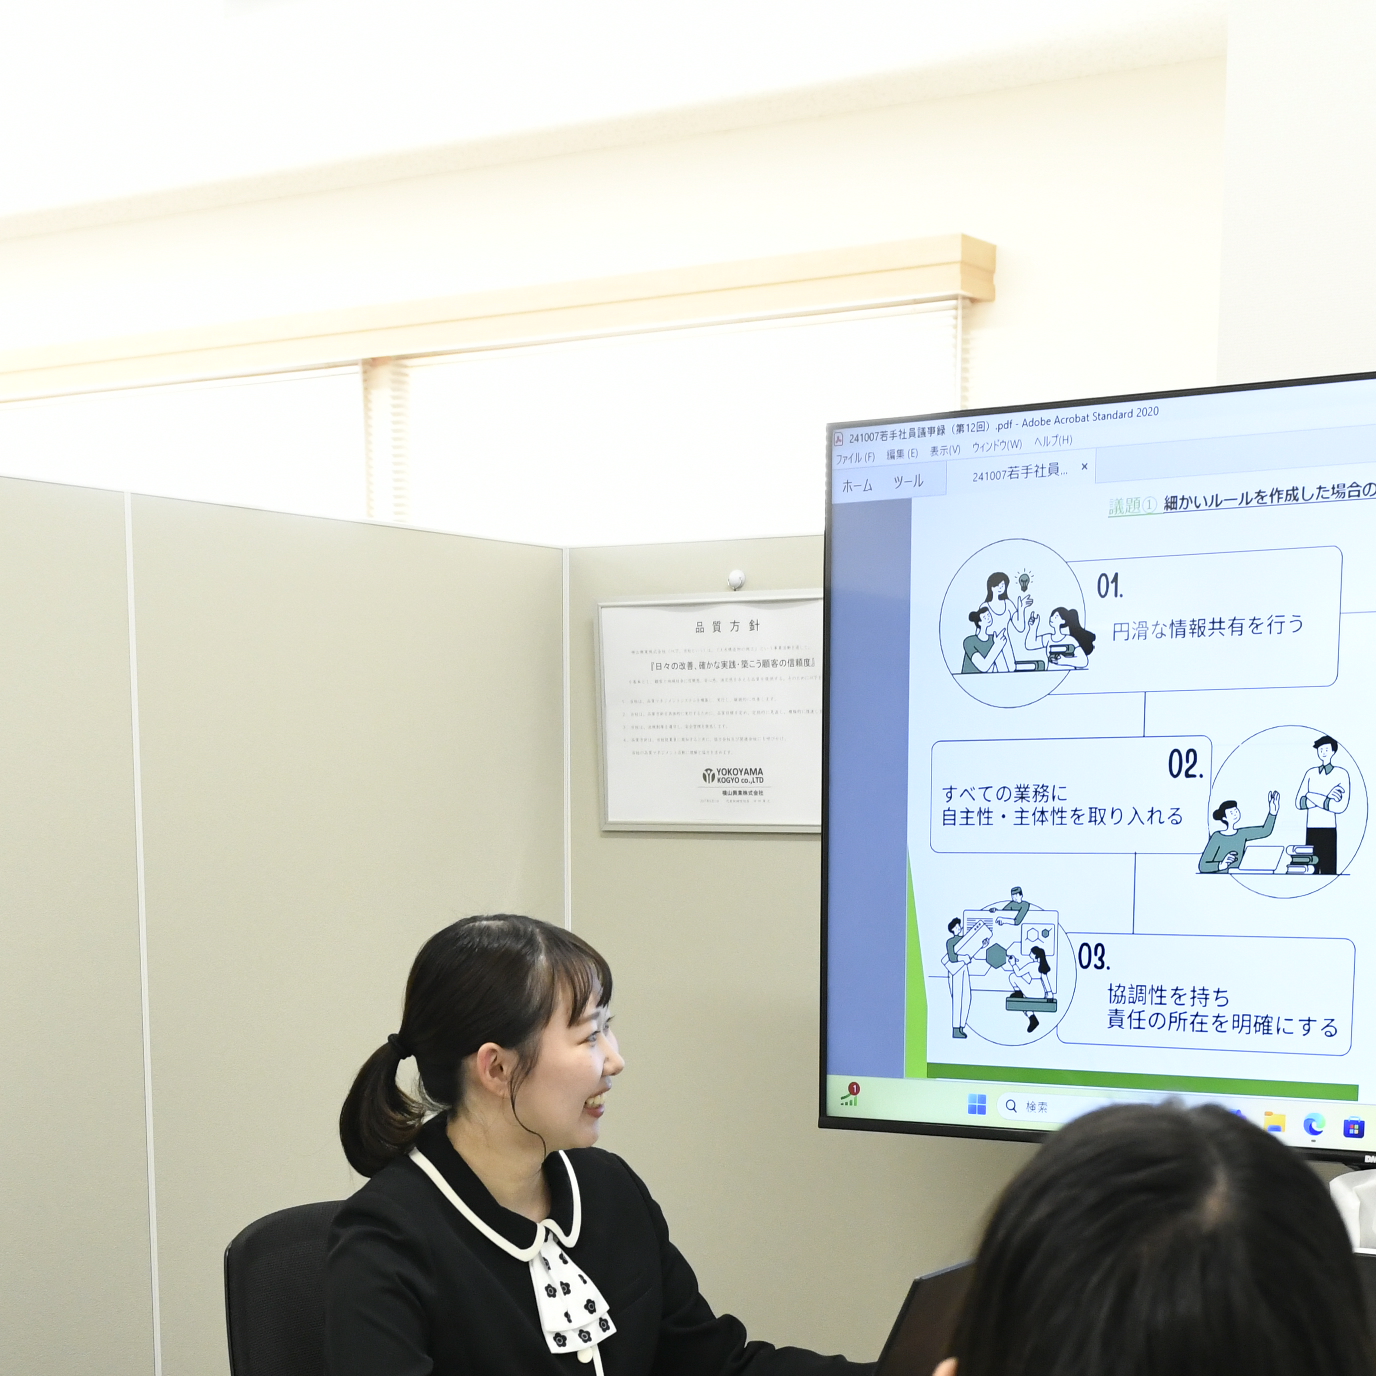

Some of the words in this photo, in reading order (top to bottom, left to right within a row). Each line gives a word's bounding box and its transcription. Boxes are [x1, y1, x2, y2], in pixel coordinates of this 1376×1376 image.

[1021, 417, 1051, 428] Adobe
[1053, 413, 1089, 425] Acrobat
[1092, 409, 1133, 422] Standard
[1136, 405, 1159, 418] 2020
[842, 478, 873, 493] ホーム
[894, 473, 924, 489] ツール
[1097, 571, 1124, 599] 01.
[1112, 614, 1303, 642] 円滑な情報共有を行う
[716, 767, 764, 776] YOKOYAMA
[1167, 747, 1204, 779] 02.
[717, 776, 740, 784] KOGYO
[942, 783, 1068, 803] すべての業務に
[942, 806, 1183, 827] 自主性・主体性を取り入れる
[1077, 941, 1111, 971] 03.
[1107, 982, 1230, 1008] 協調性を持ち
[1107, 1008, 1339, 1038] 責任の所在を明確にする
[1025, 1101, 1049, 1114] 検索
